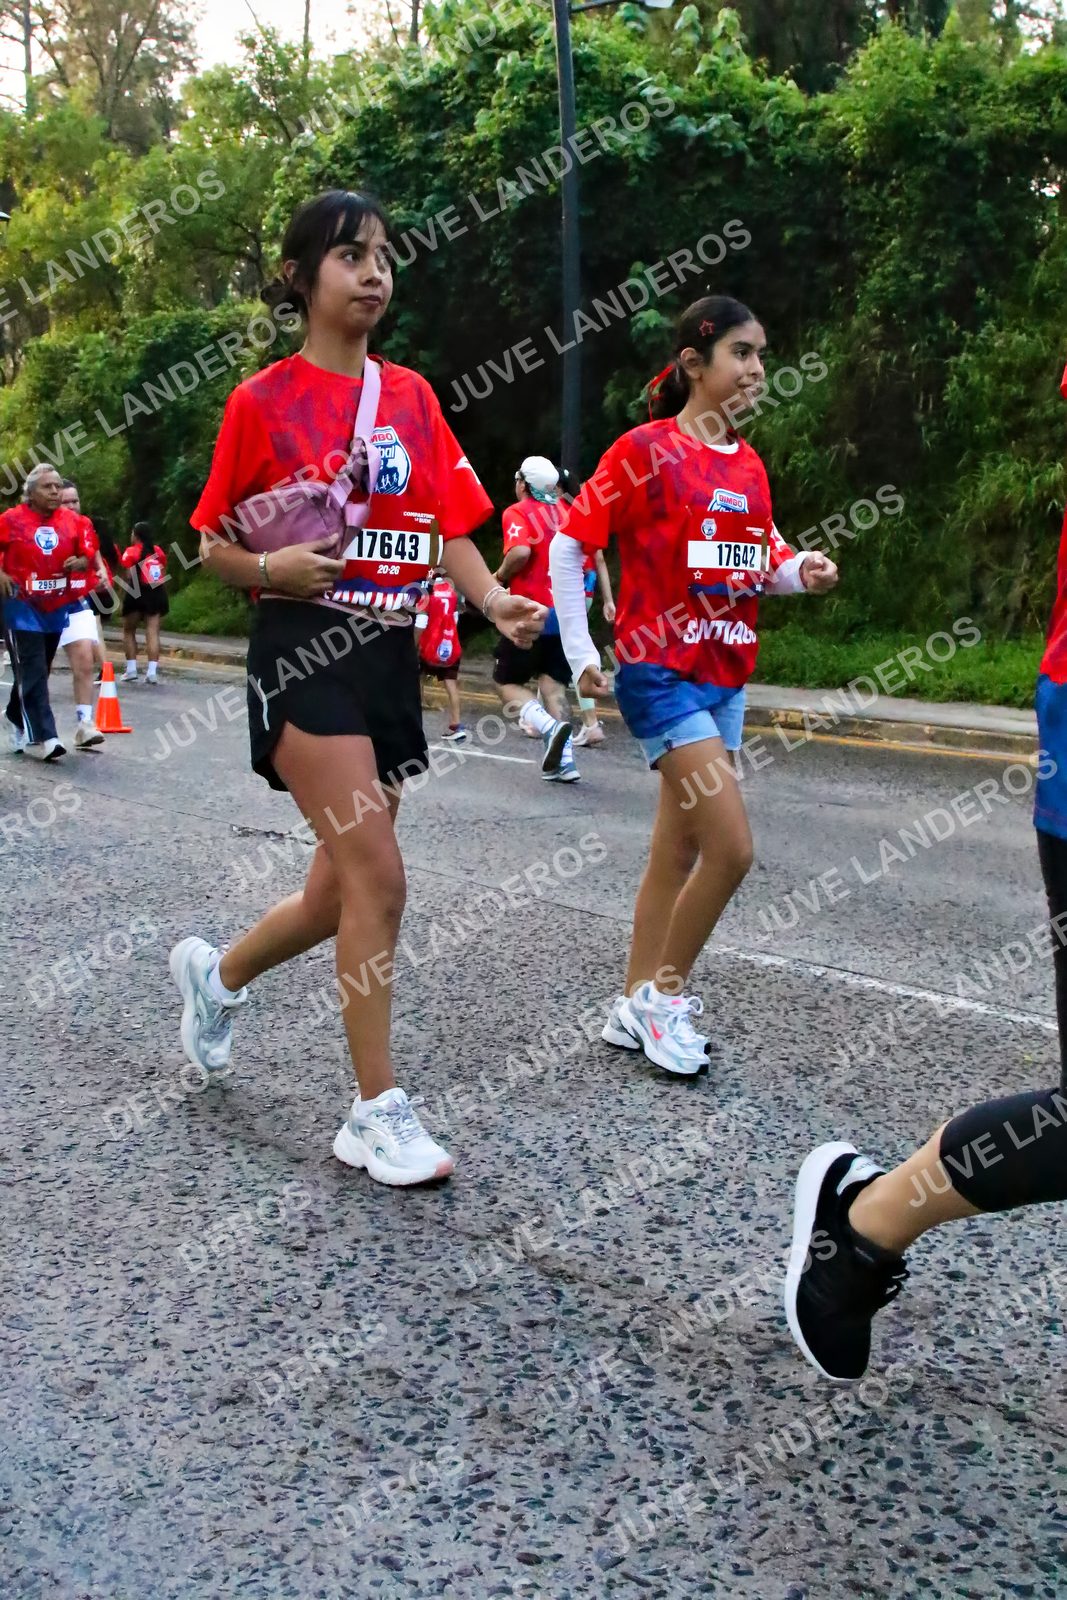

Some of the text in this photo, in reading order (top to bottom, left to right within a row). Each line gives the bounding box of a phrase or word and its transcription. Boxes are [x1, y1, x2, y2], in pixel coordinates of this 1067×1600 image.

[370, 432, 393, 443] MBO
[356, 531, 420, 561] 17643
[717, 544, 756, 568] 17642
[683, 617, 756, 644] SNTIAG
